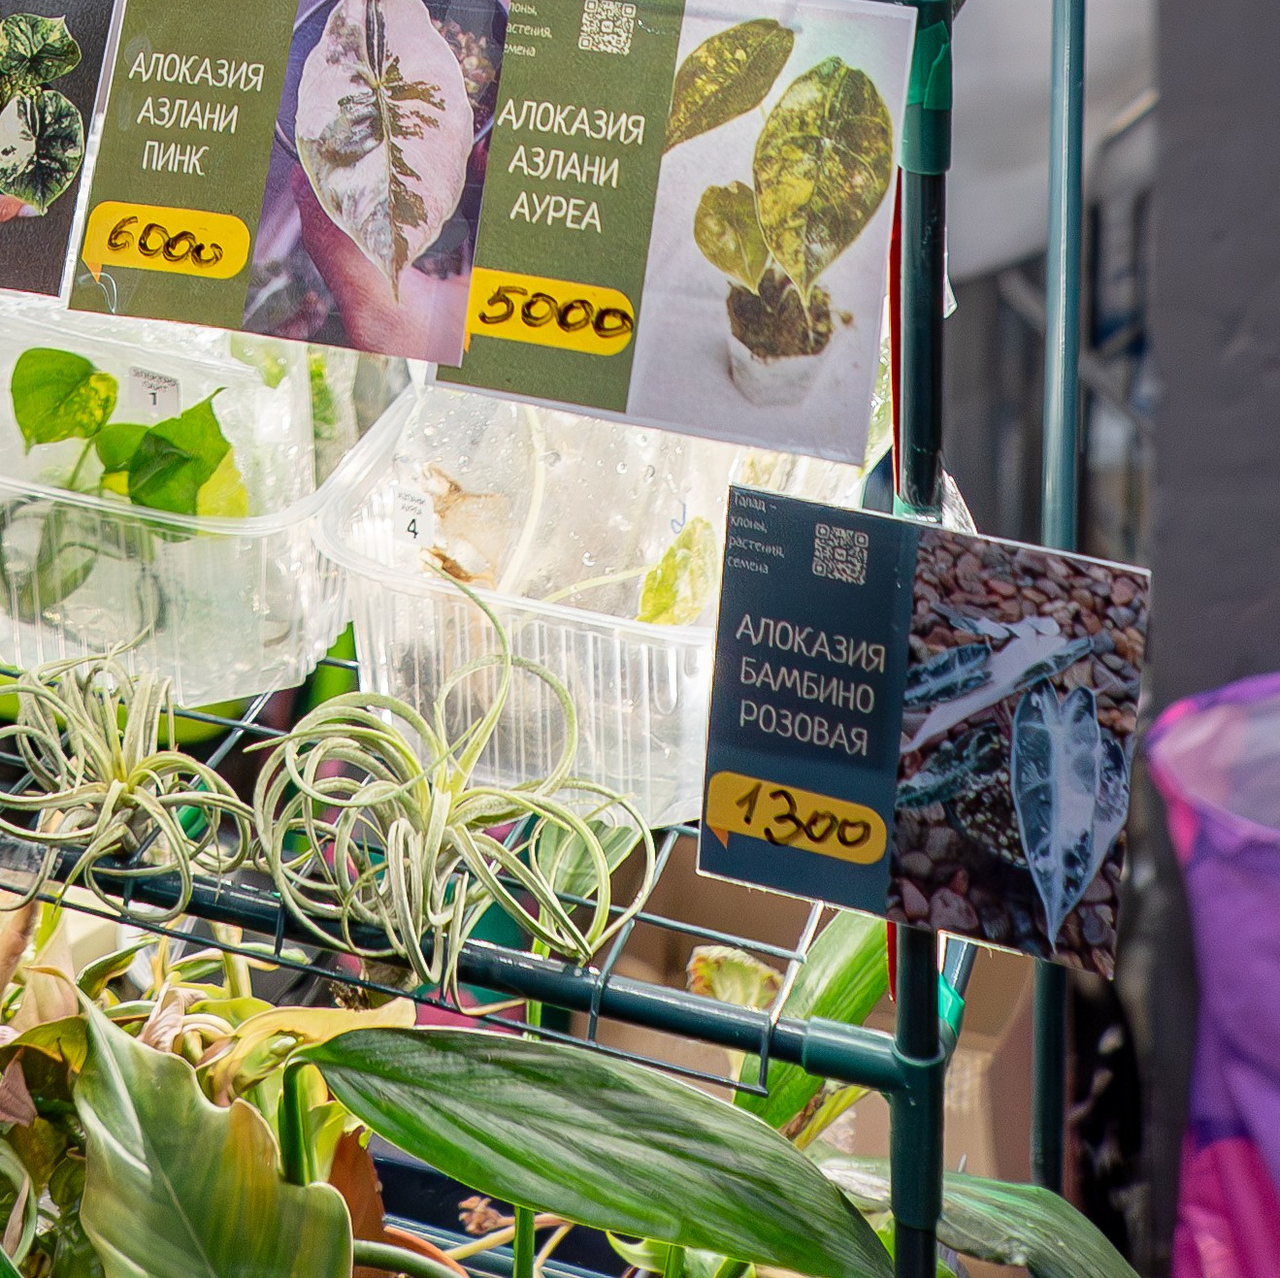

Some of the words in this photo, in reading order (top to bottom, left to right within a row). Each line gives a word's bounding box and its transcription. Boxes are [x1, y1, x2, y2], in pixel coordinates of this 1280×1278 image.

[506, 23, 552, 39] астения,
[509, 2, 537, 17] лоны,
[128, 51, 265, 92] АЛОКАЗИЯ
[504, 43, 536, 57] емена
[136, 96, 238, 134] АЗЛАНИ
[497, 98, 646, 146] АЛОКАЗИЯ
[142, 140, 209, 176] ПИНК
[507, 144, 620, 189] АЗЛАНИ
[509, 190, 602, 234] АУРЕА
[107, 215, 224, 269] 6000
[478, 285, 634, 339] 5000
[407, 518, 418, 539] 4
[727, 556, 769, 575] семена
[736, 613, 886, 674] АЛОКАЗИЯ
[740, 657, 875, 714] БАМБИНО
[739, 699, 869, 757] РОЗОВАЯ
[735, 781, 872, 847] 1300
